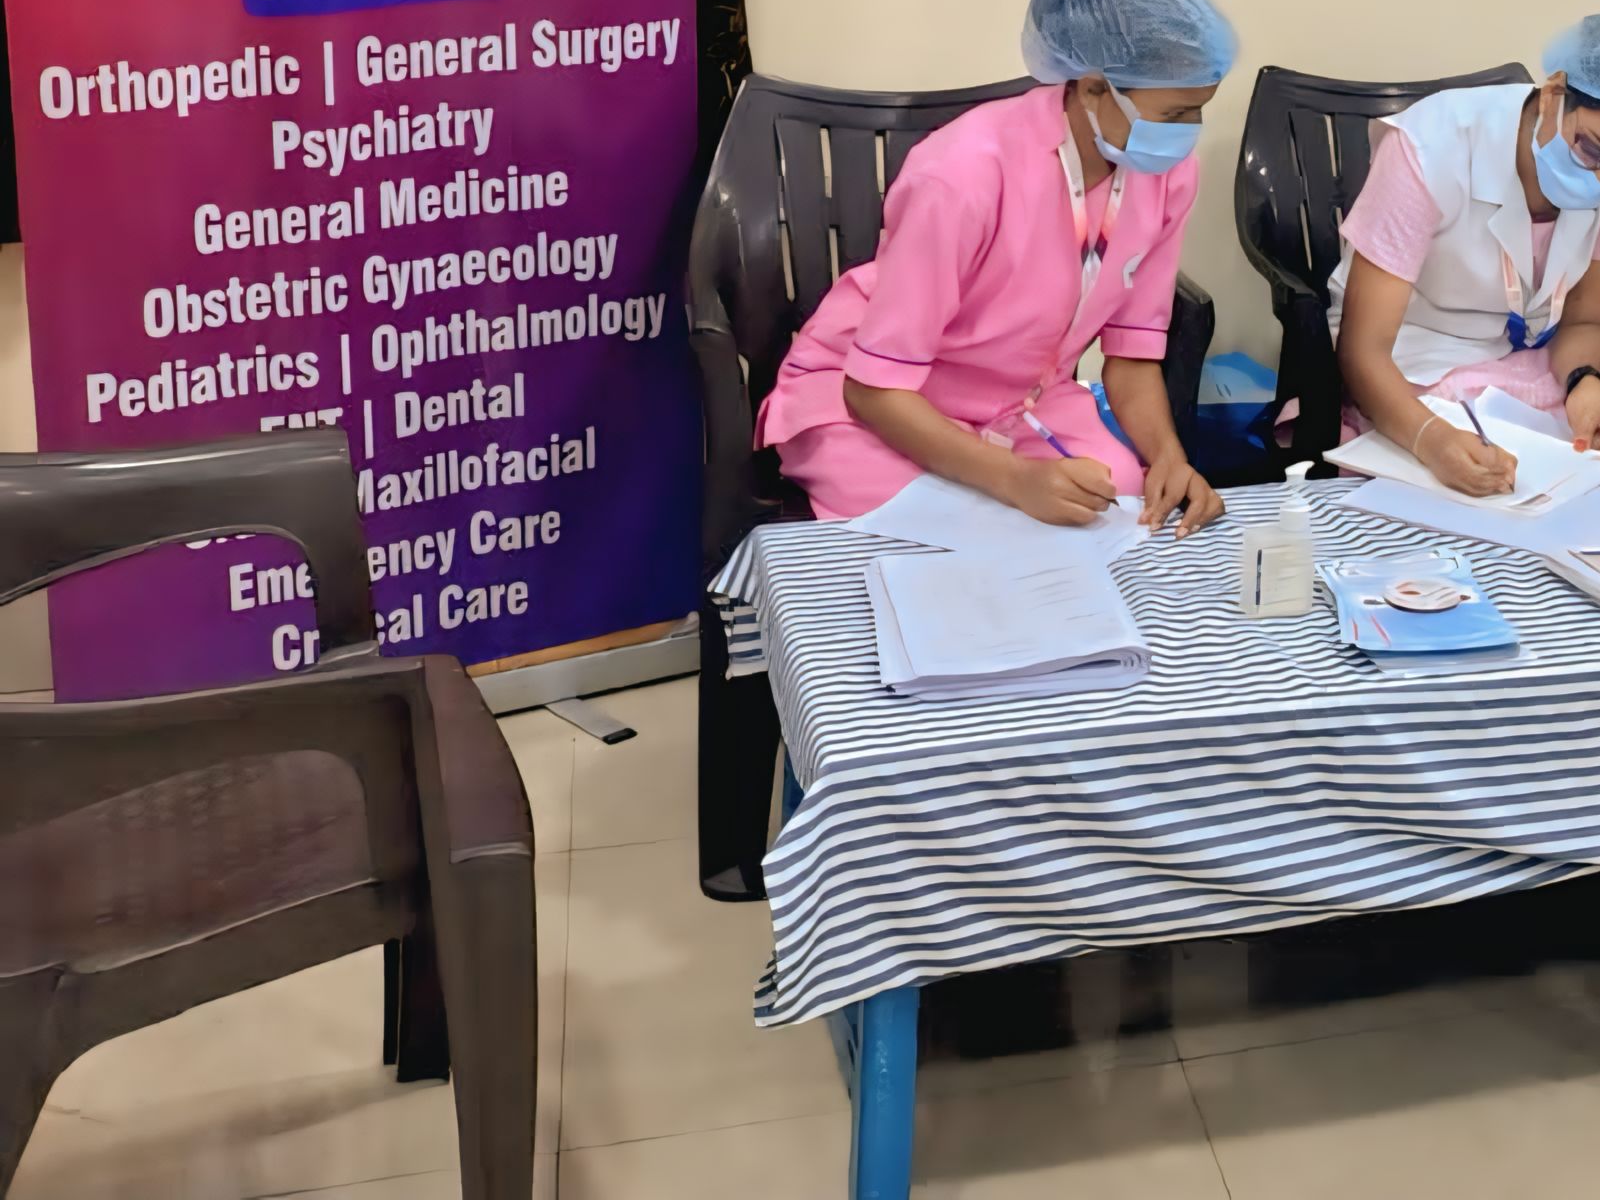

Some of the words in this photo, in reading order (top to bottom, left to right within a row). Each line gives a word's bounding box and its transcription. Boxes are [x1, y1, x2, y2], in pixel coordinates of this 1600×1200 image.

[40, 46, 300, 119] Orthopedic
[357, 23, 516, 86] General
[532, 18, 680, 72] Surgery
[272, 105, 494, 175] Psychiatry
[194, 187, 364, 254] General
[380, 166, 568, 228] Medicine
[144, 267, 348, 337] Obstetric
[362, 233, 618, 310] Gynaecology
[85, 345, 319, 423] Pediatrics
[371, 292, 666, 378] Ophthalmology
[395, 373, 524, 438] Dental
[471, 511, 560, 554] Care
[440, 582, 527, 628] Care
